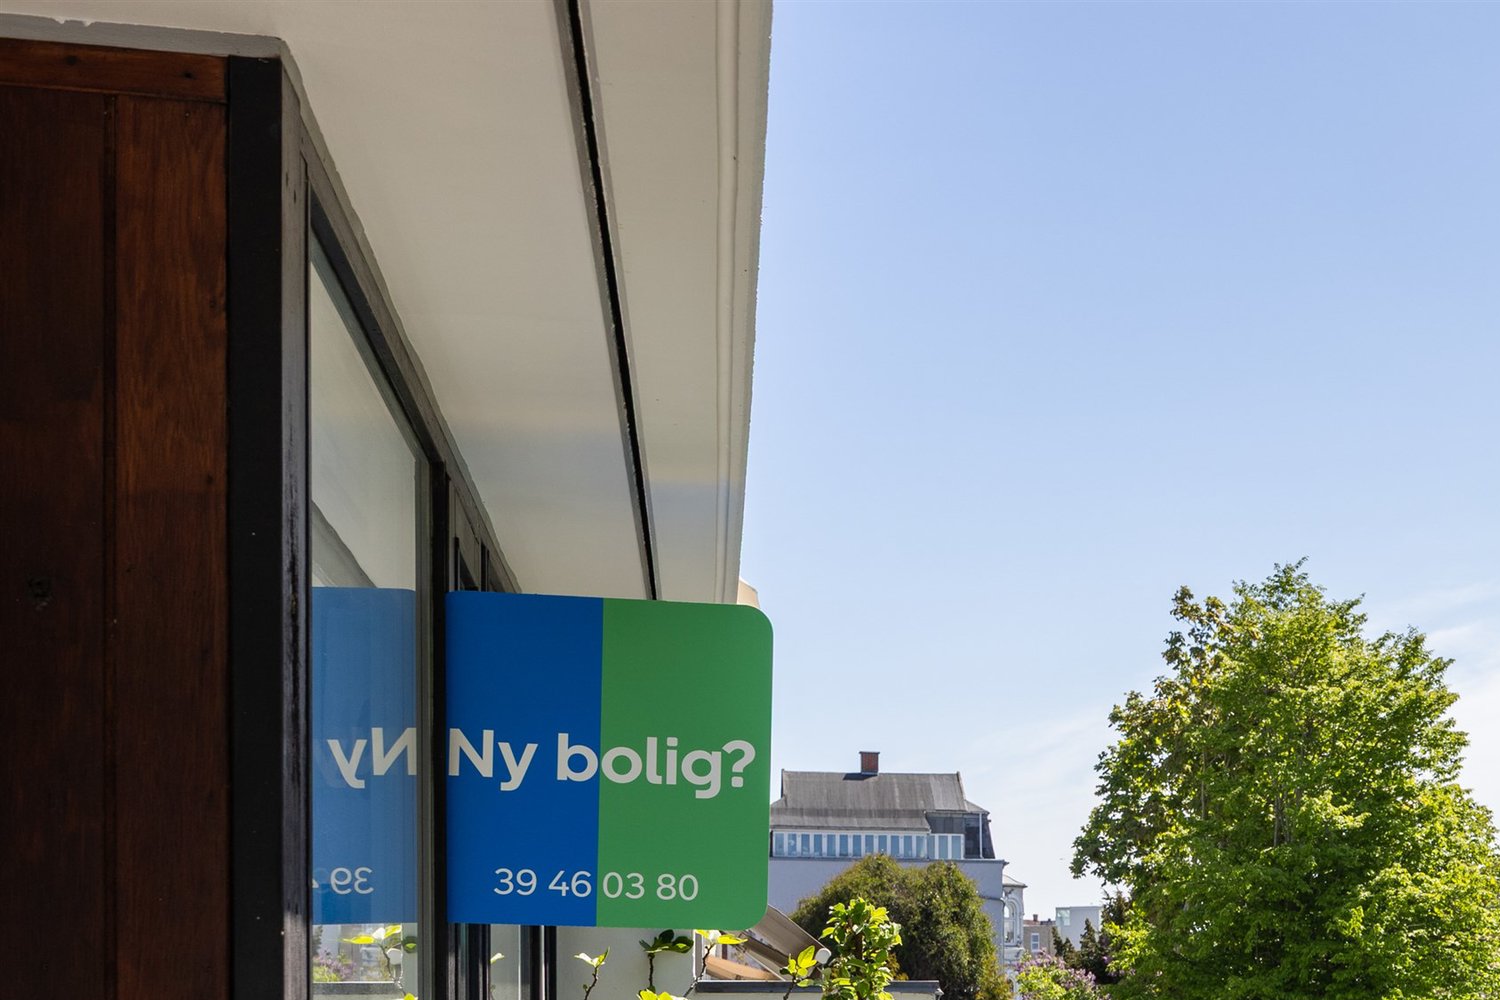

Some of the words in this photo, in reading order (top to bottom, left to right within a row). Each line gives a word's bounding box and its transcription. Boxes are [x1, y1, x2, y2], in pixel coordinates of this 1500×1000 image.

[448, 728, 538, 791] Ny
[557, 733, 756, 799] bolig?
[493, 868, 537, 896] 39
[548, 870, 592, 898] 46
[602, 872, 645, 900] 03
[656, 873, 699, 902] 80
